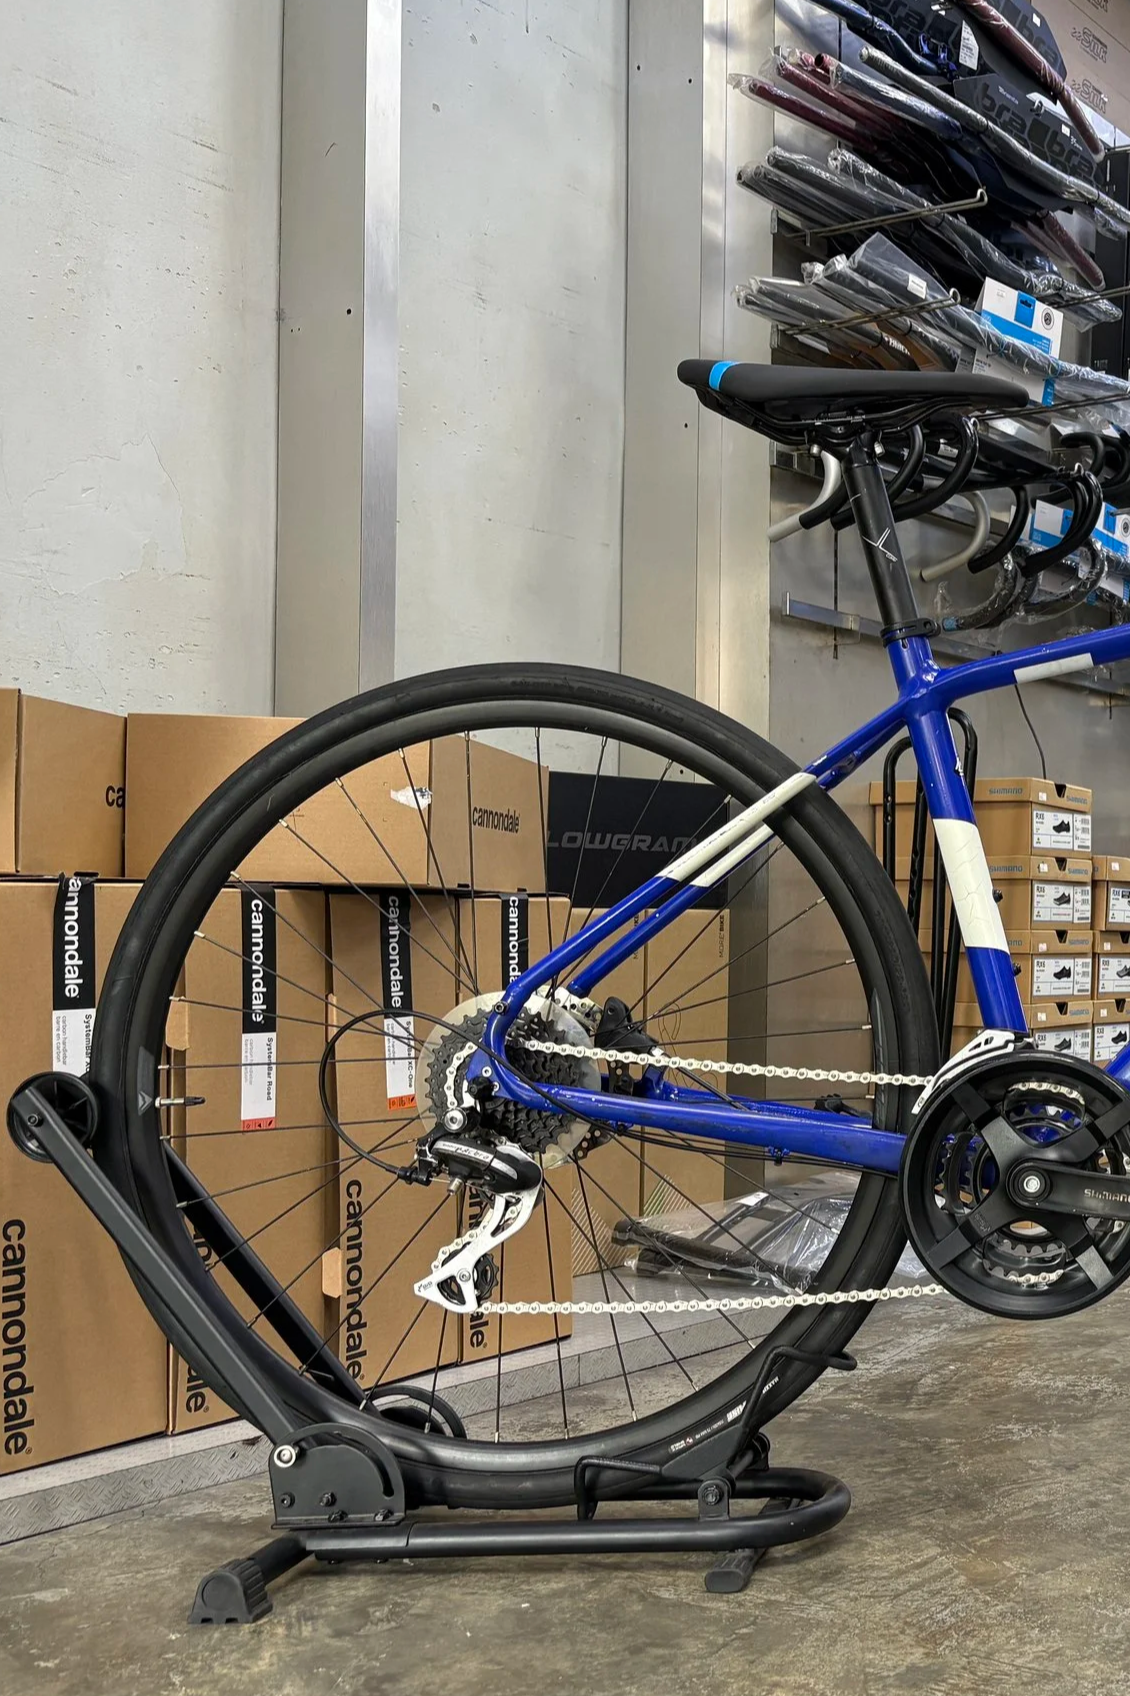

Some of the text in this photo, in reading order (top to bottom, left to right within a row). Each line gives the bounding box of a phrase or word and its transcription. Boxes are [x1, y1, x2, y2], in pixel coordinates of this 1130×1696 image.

[472, 805, 520, 834] cannondale
[64, 877, 84, 999] annondale
[250, 899, 267, 1024] cannondale
[388, 895, 404, 1008] cannondale
[1, 1218, 35, 1456] cannondale
[344, 1180, 366, 1383] cannondale
